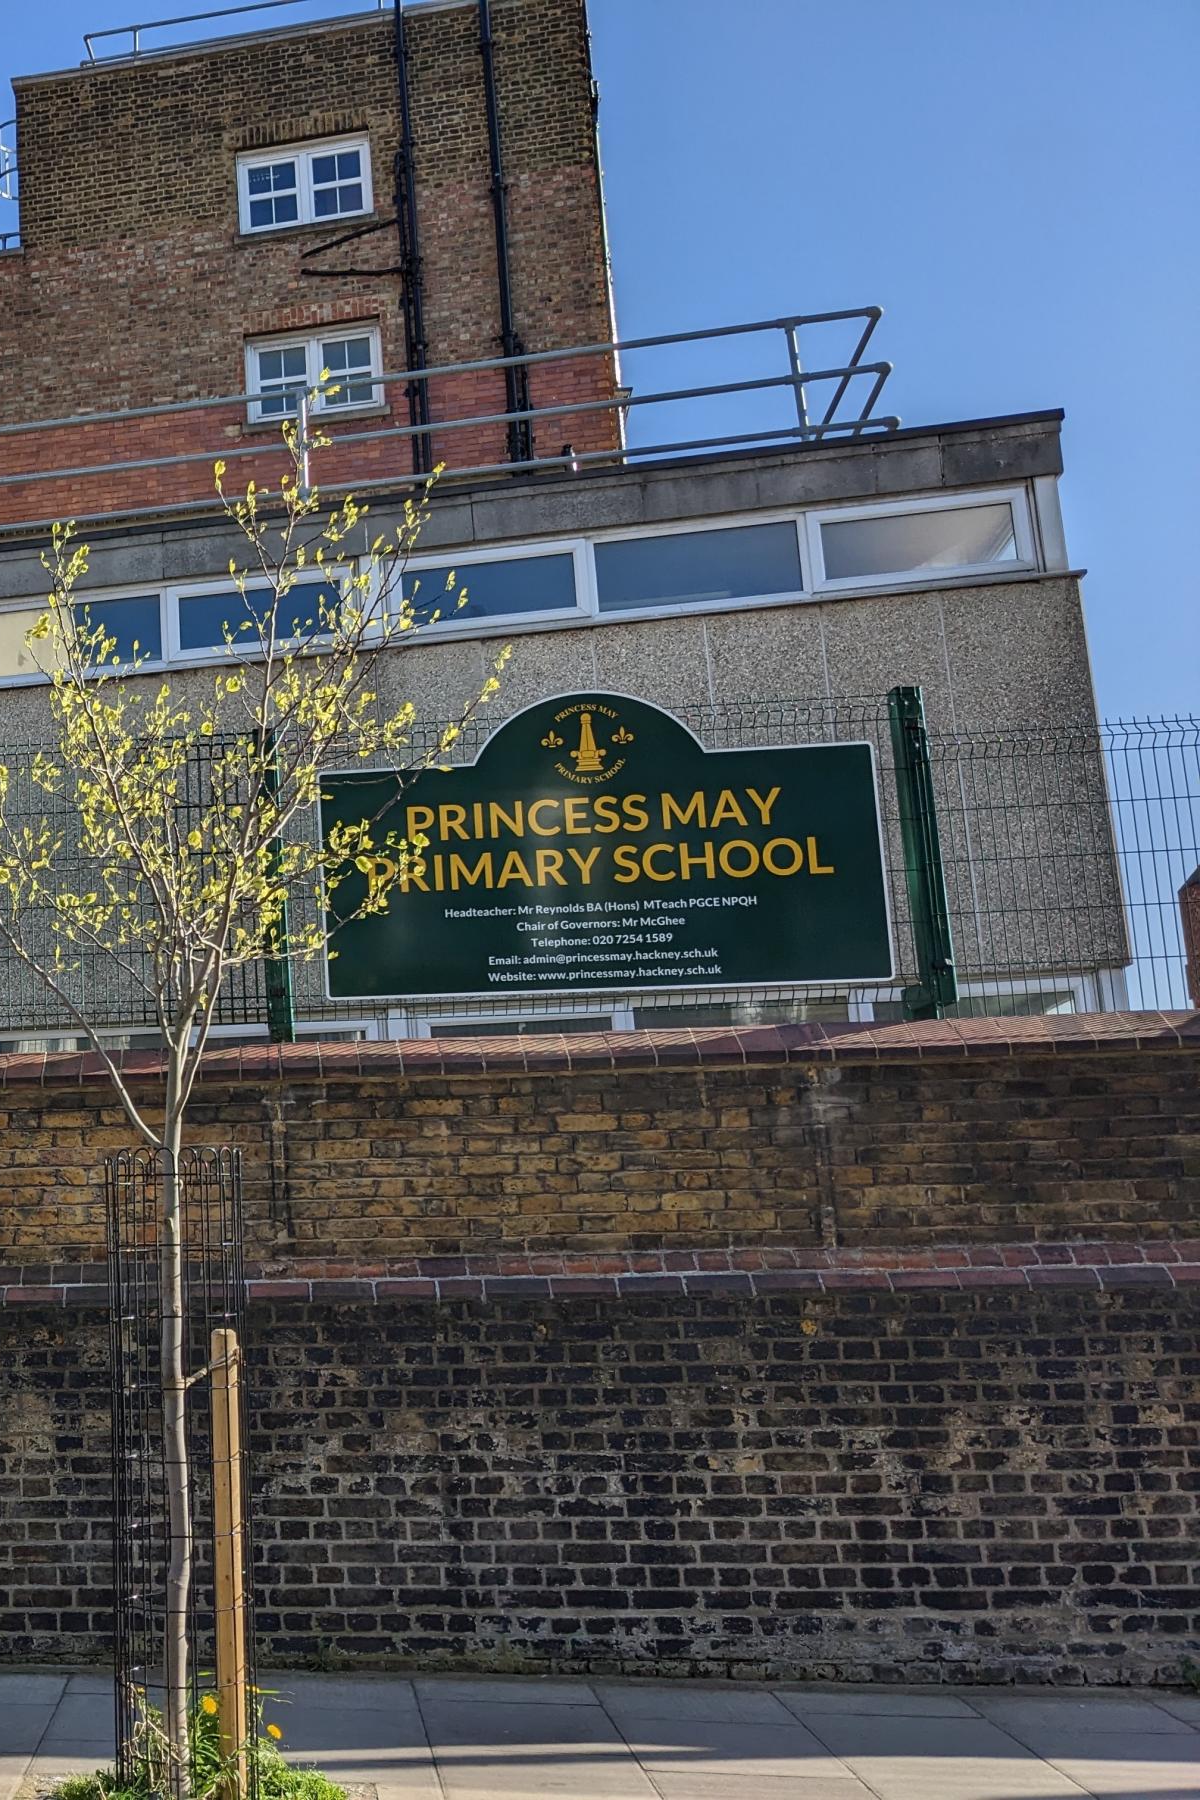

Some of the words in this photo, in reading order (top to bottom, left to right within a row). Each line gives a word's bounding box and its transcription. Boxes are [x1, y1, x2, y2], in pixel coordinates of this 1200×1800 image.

[554, 703, 597, 722] PRINCESS
[598, 705, 619, 719] MAY
[554, 762, 593, 784] PRIMARY
[595, 758, 626, 783] SCHOOL
[405, 794, 649, 841] PRINCESS
[661, 786, 782, 830] MAY
[368, 846, 602, 893] PRIMARY
[612, 836, 835, 884] SCHOOL
[444, 907, 517, 918] Headteacher:
[517, 905, 534, 915] Mr
[535, 903, 585, 916] Reynolds
[586, 902, 603, 913] BA
[604, 900, 640, 913] (Hons)
[643, 899, 688, 910] MTeach
[689, 898, 720, 908] PGCE
[721, 895, 758, 907] NPQH
[516, 921, 546, 932] Chair
[547, 920, 559, 931] of
[560, 918, 621, 930] Governors:
[622, 917, 639, 927] Mr
[640, 915, 686, 926] McGhee
[530, 937, 591, 949] Telephone:
[592, 935, 614, 945] 020
[615, 934, 644, 944] 7254
[645, 932, 673, 943] 1589
[488, 955, 522, 966] Email:
[522, 947, 719, 965] admin@princessmay.hackney.sch.uk
[488, 971, 537, 982] Website:
[537, 964, 723, 981] www.princessmay.hackney.sch.uk
